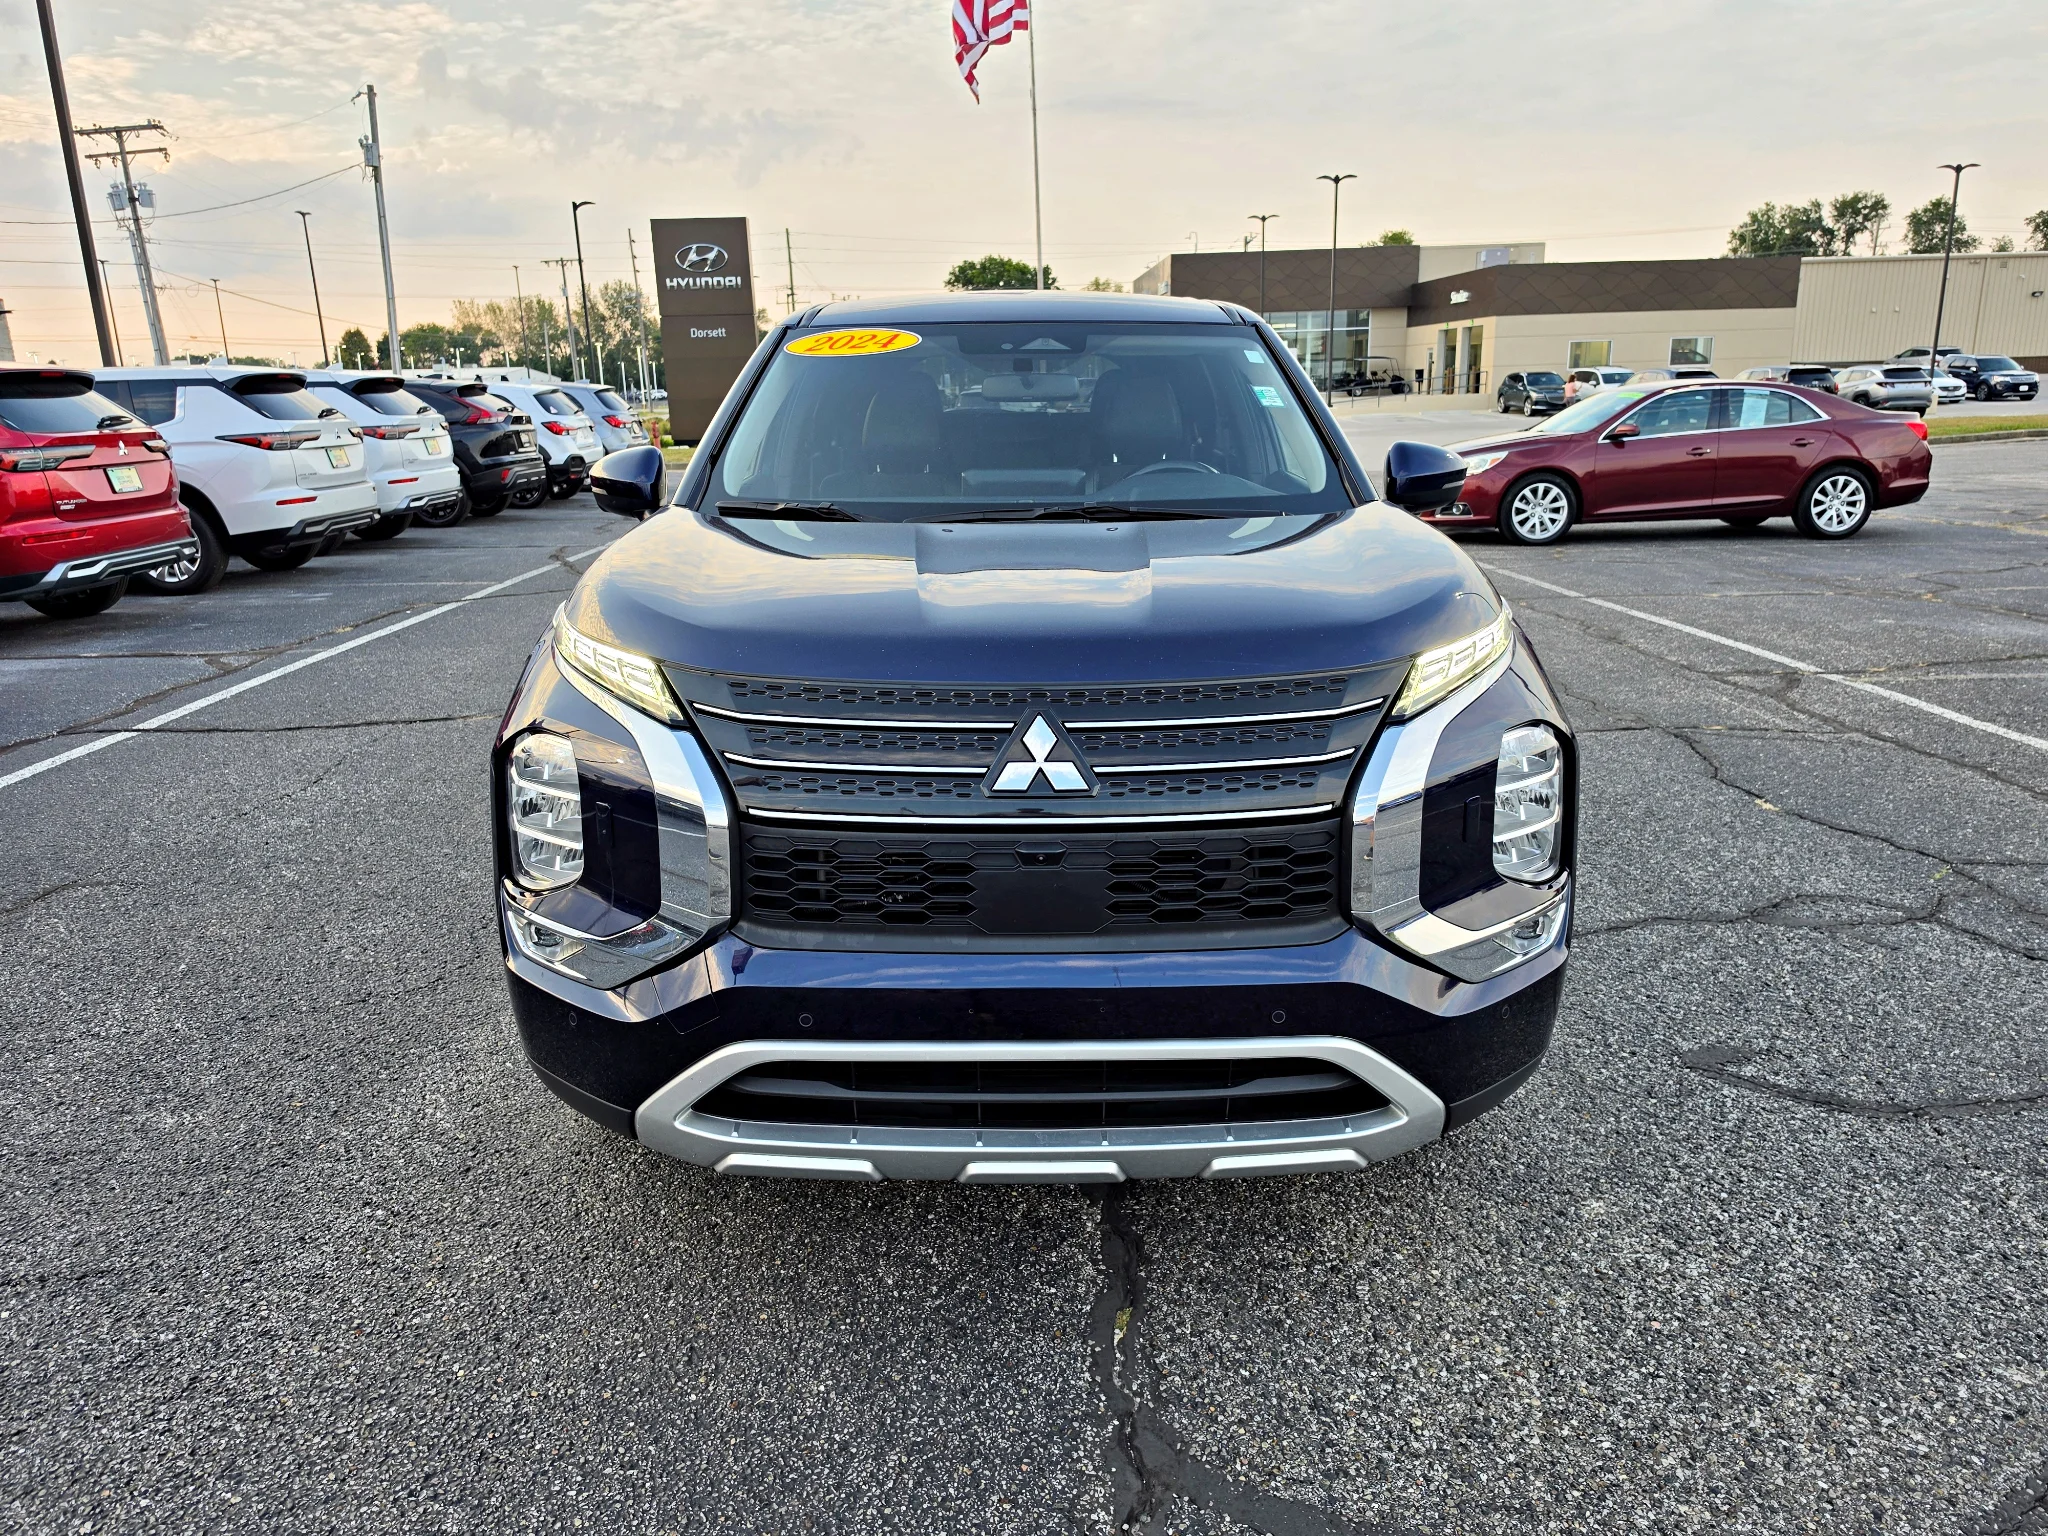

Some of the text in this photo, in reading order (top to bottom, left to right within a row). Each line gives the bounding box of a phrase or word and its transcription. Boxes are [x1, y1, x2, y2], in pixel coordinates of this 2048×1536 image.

[665, 276, 742, 290] HYUNDAI
[690, 327, 727, 339] Dorsett
[804, 333, 899, 352] 2024
